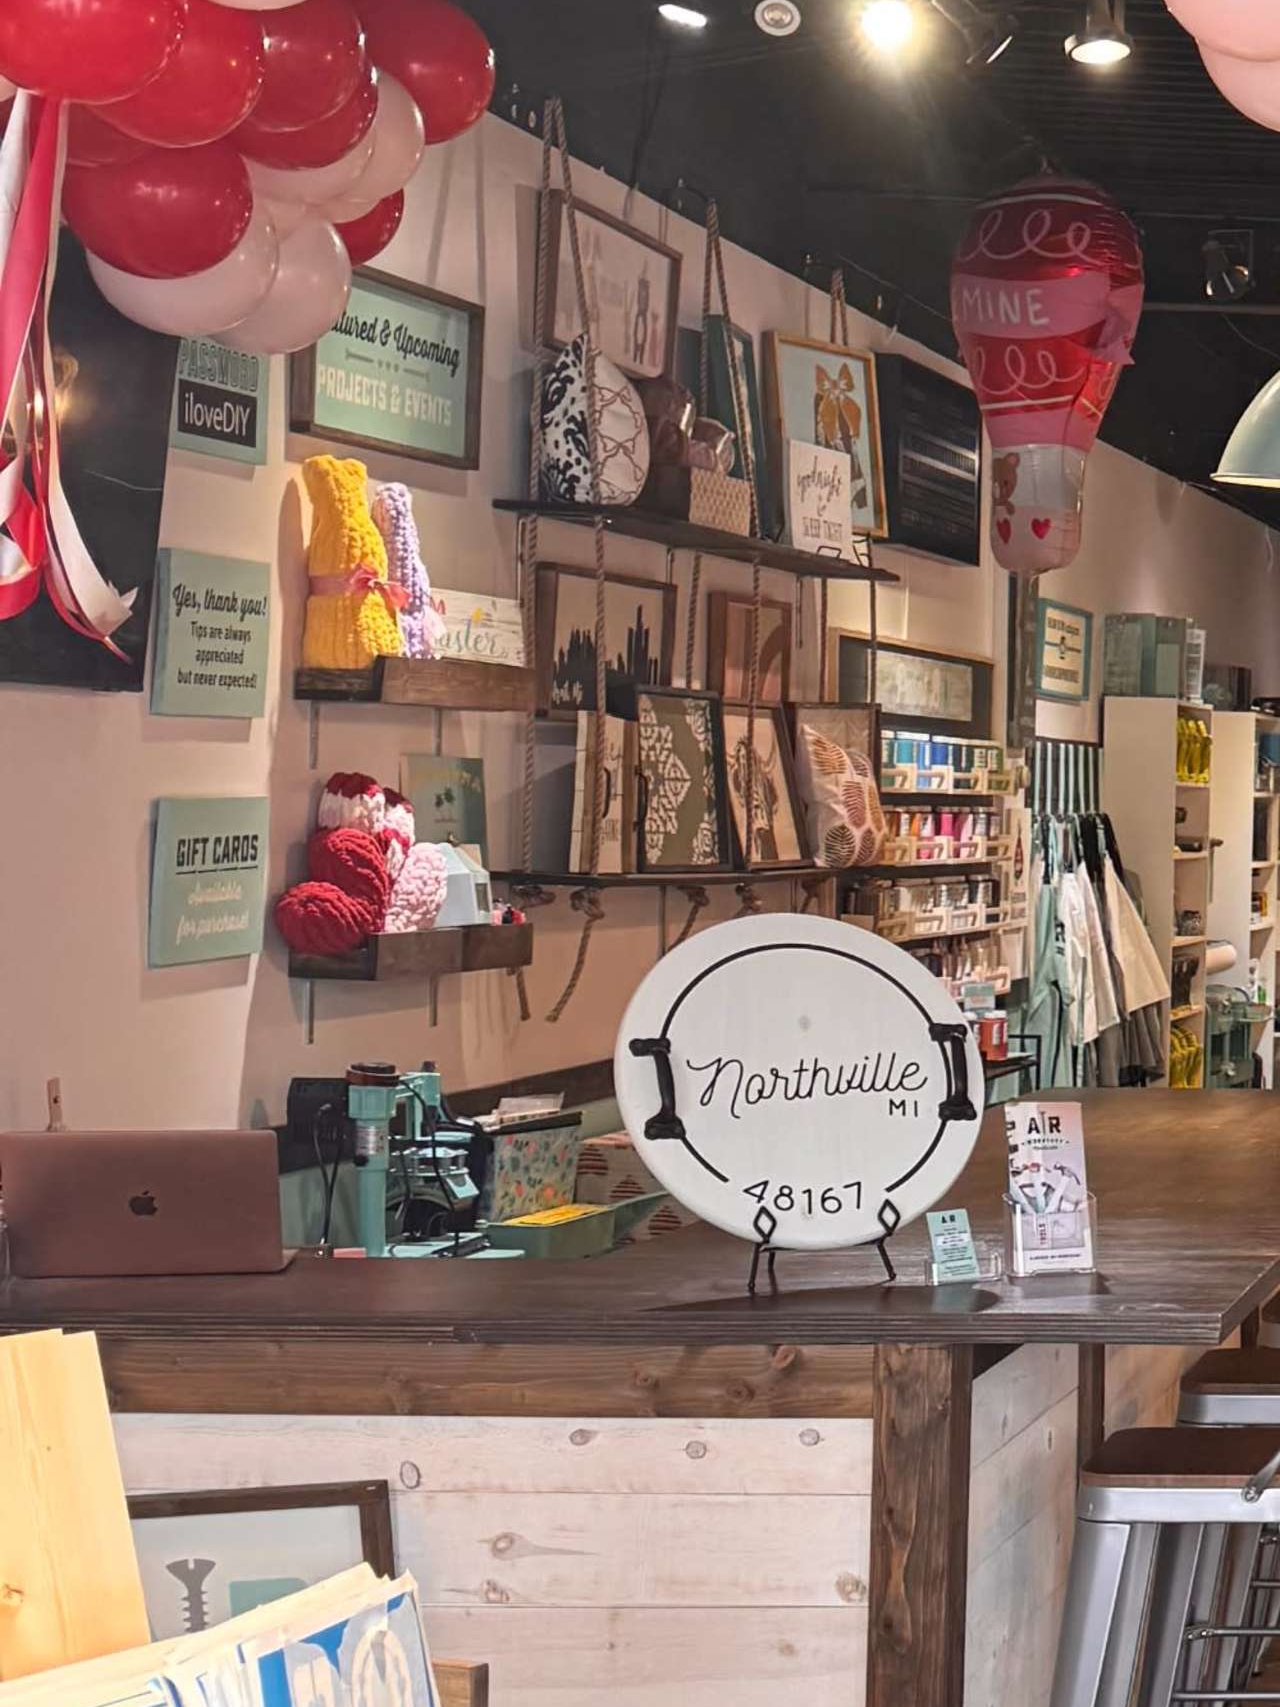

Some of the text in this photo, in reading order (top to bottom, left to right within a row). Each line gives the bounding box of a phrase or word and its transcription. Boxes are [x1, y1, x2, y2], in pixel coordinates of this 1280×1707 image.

[961, 287, 1050, 327] MINE
[380, 318, 391, 346] &
[394, 327, 460, 379] Upcoming
[318, 364, 452, 426] PROJECTS & EVENTS
[184, 393, 250, 436] iloveDIY
[173, 583, 267, 622] Yes, thank you!
[191, 621, 252, 644] Tips are always
[432, 617, 496, 655] aster
[195, 648, 244, 666] appreciated
[177, 668, 257, 690] but never expected!
[176, 834, 258, 867] GIFT CARDS
[687, 1052, 928, 1119] Northville
[889, 1099, 918, 1117] MI
[743, 1180, 862, 1215] 48167
